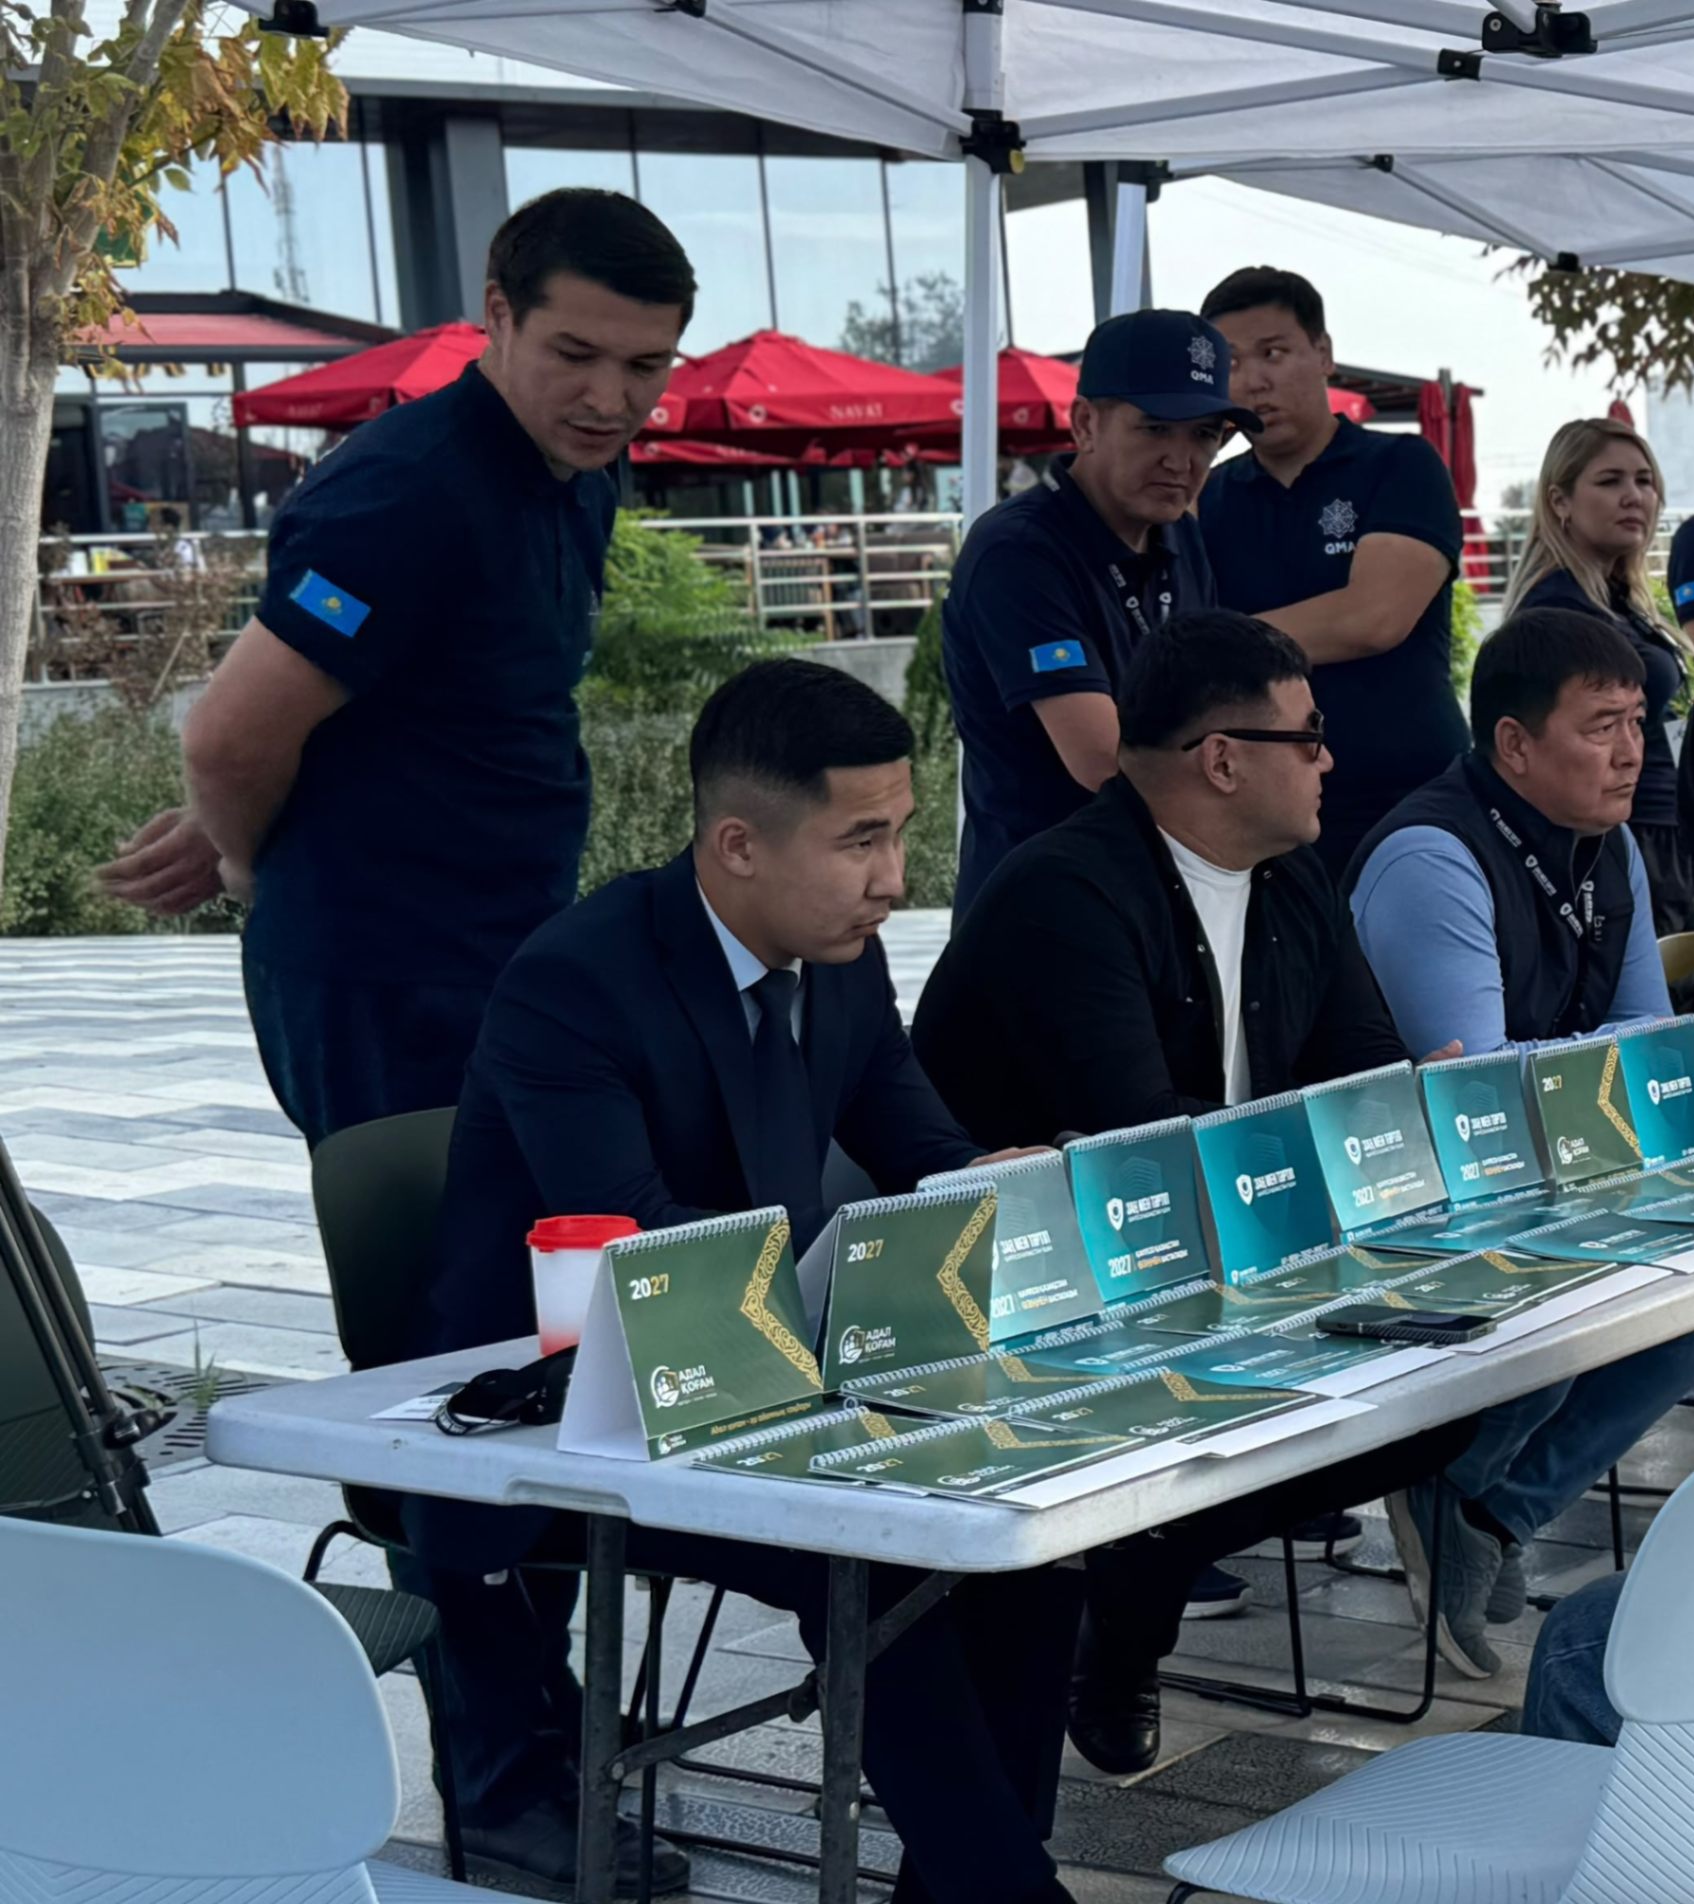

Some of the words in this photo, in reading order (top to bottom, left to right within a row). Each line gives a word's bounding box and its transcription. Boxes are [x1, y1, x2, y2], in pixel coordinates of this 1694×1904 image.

[847, 1239, 884, 1262] 2027
[629, 1273, 669, 1300] 2027
[865, 1326, 892, 1341] АДАЛ
[678, 1365, 706, 1382] АДАЛ
